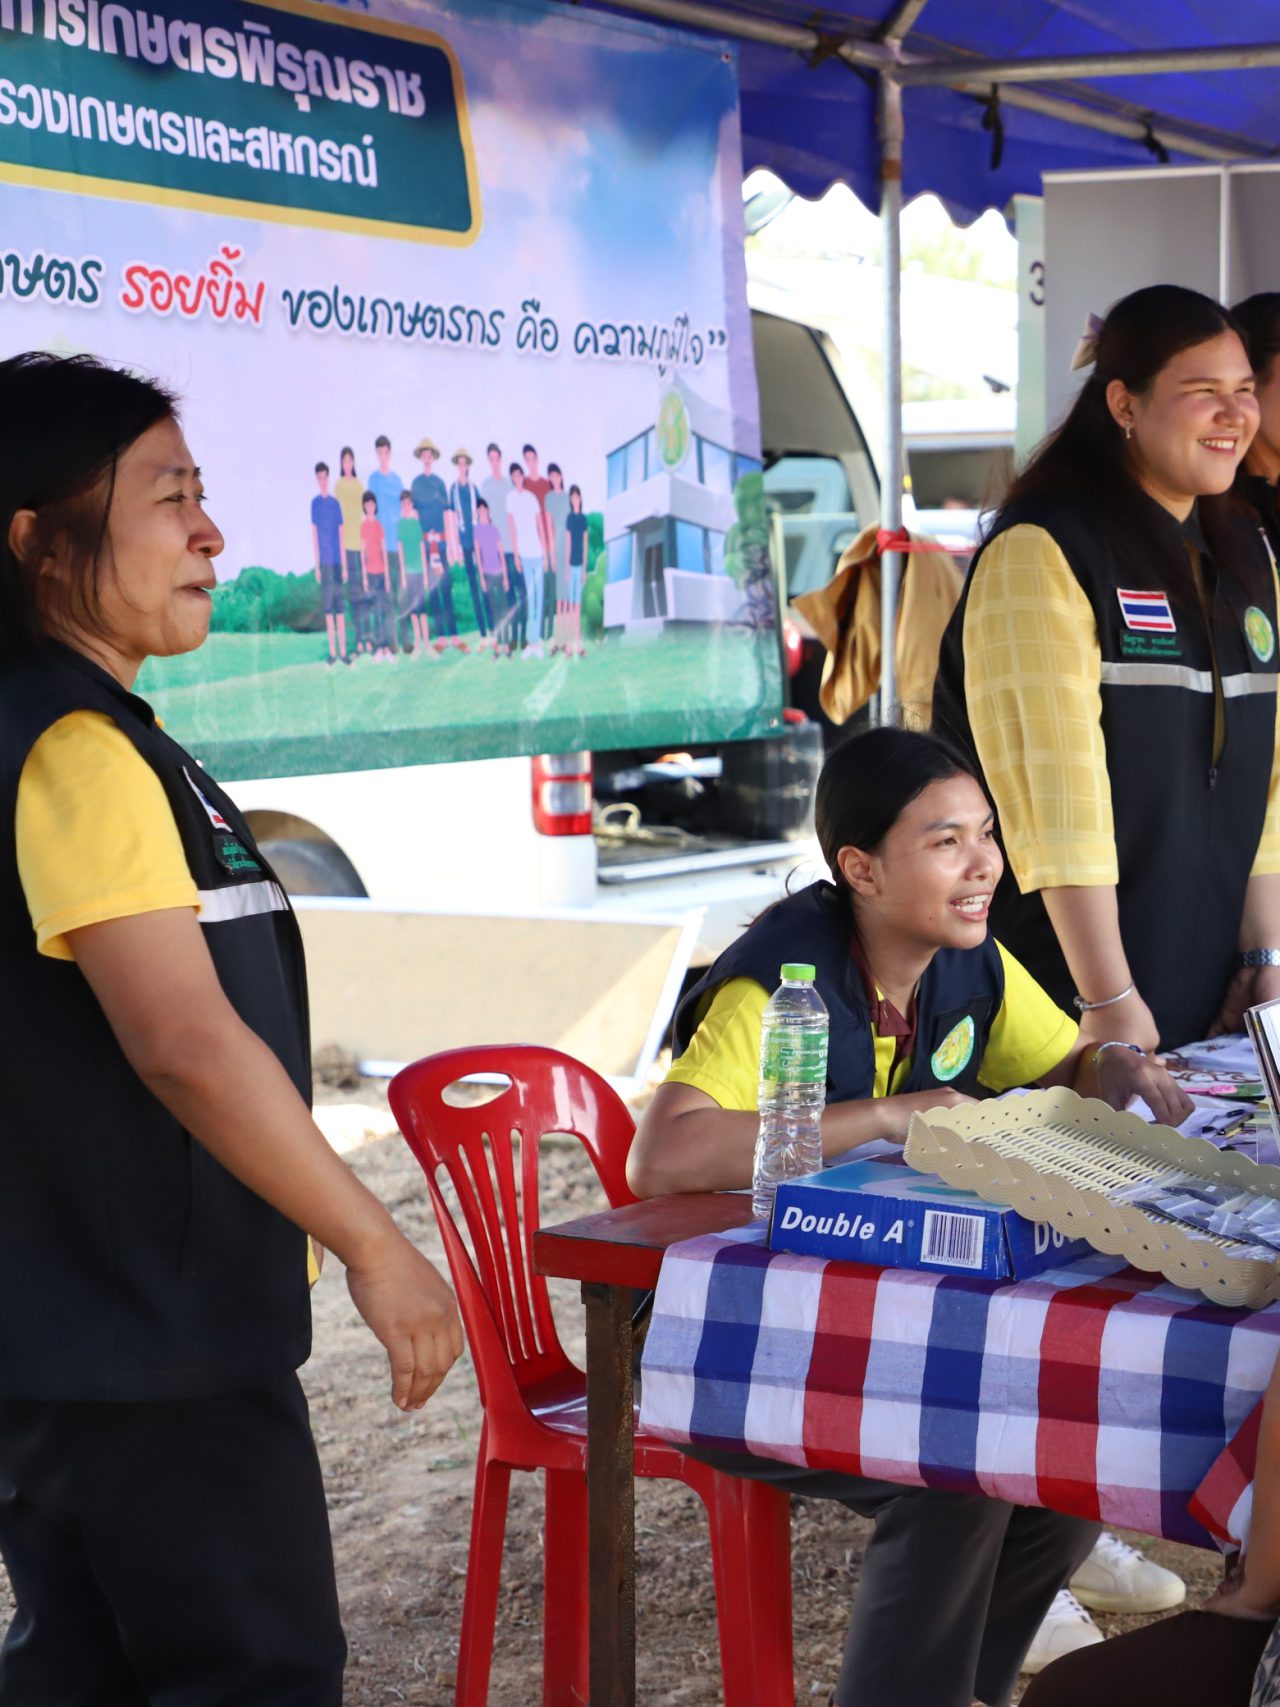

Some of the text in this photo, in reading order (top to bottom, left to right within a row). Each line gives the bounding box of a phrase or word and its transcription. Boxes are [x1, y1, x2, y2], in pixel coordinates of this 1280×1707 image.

[0, 253, 102, 303] ษตร
[122, 246, 265, 323] รอยยิ้ม
[282, 284, 505, 346] ของเกษตรกร
[516, 298, 559, 352] คือ
[780, 1206, 876, 1240] Double
